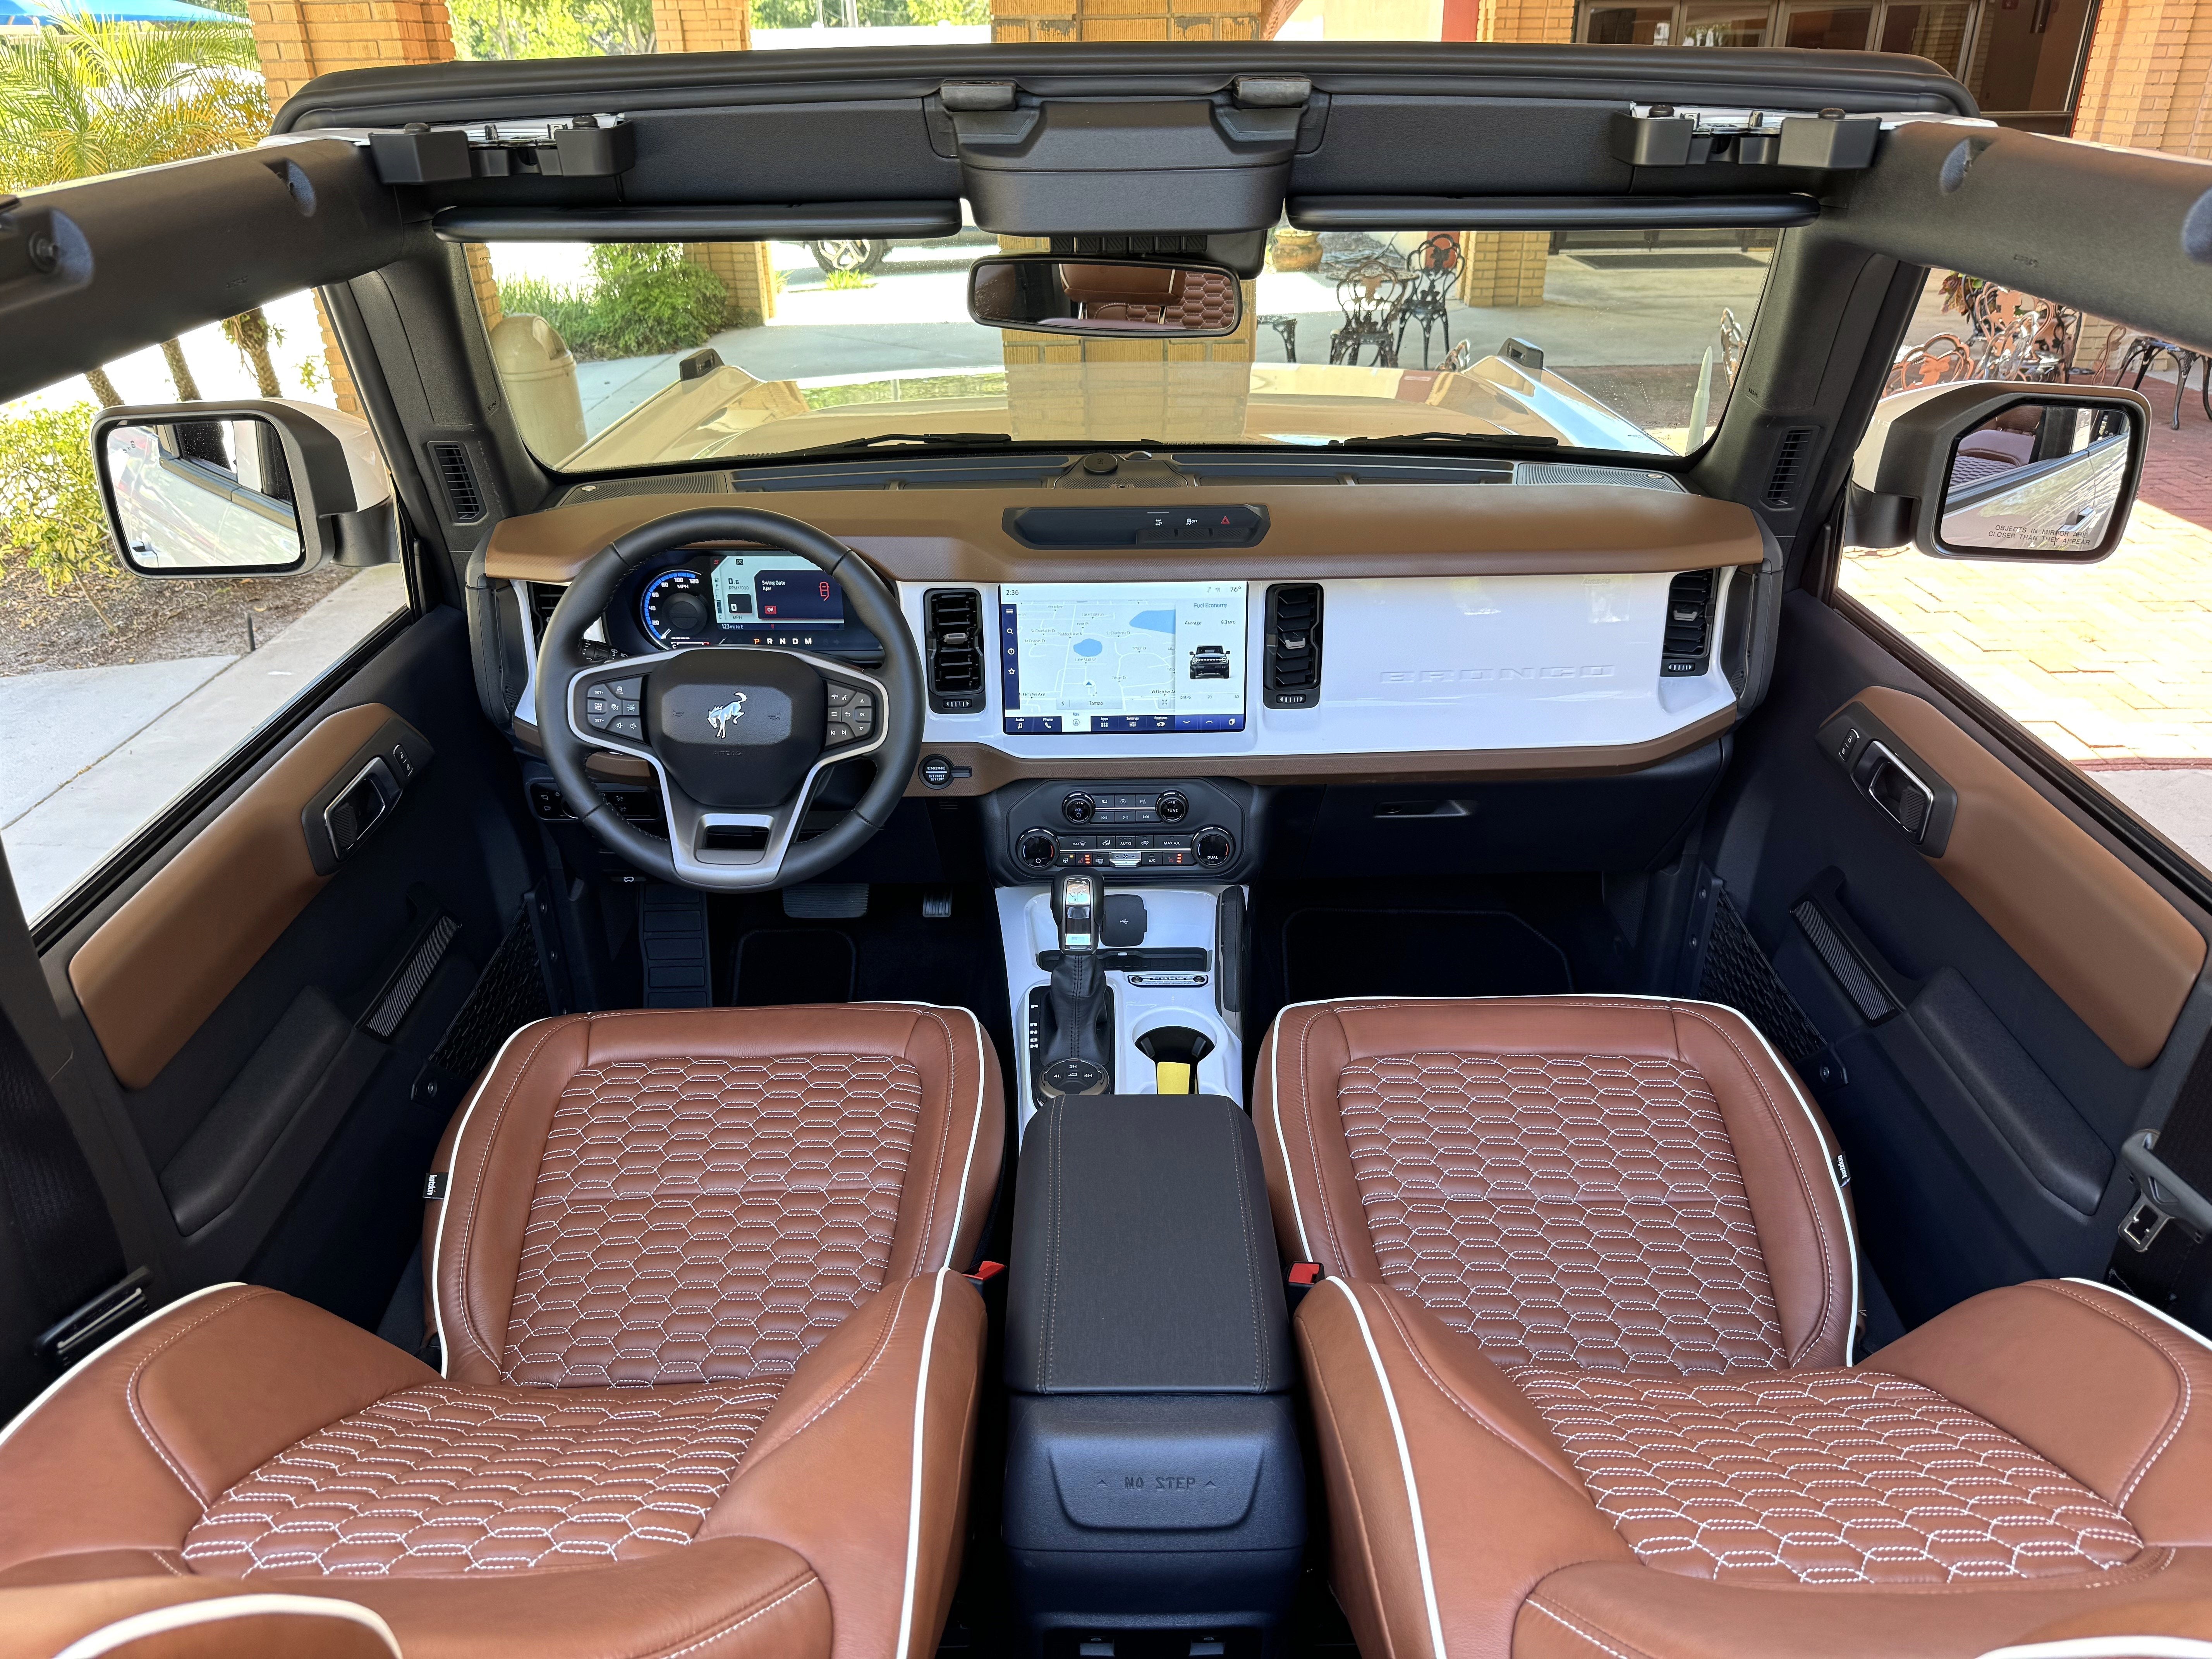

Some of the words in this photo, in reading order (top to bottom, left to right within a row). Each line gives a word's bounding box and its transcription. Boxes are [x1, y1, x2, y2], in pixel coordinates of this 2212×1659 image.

[730, 603, 737, 611] 0
[1380, 665, 1615, 684] BRONCO
[1124, 1476, 1144, 1491] NO
[1156, 1476, 1196, 1491] STEP
